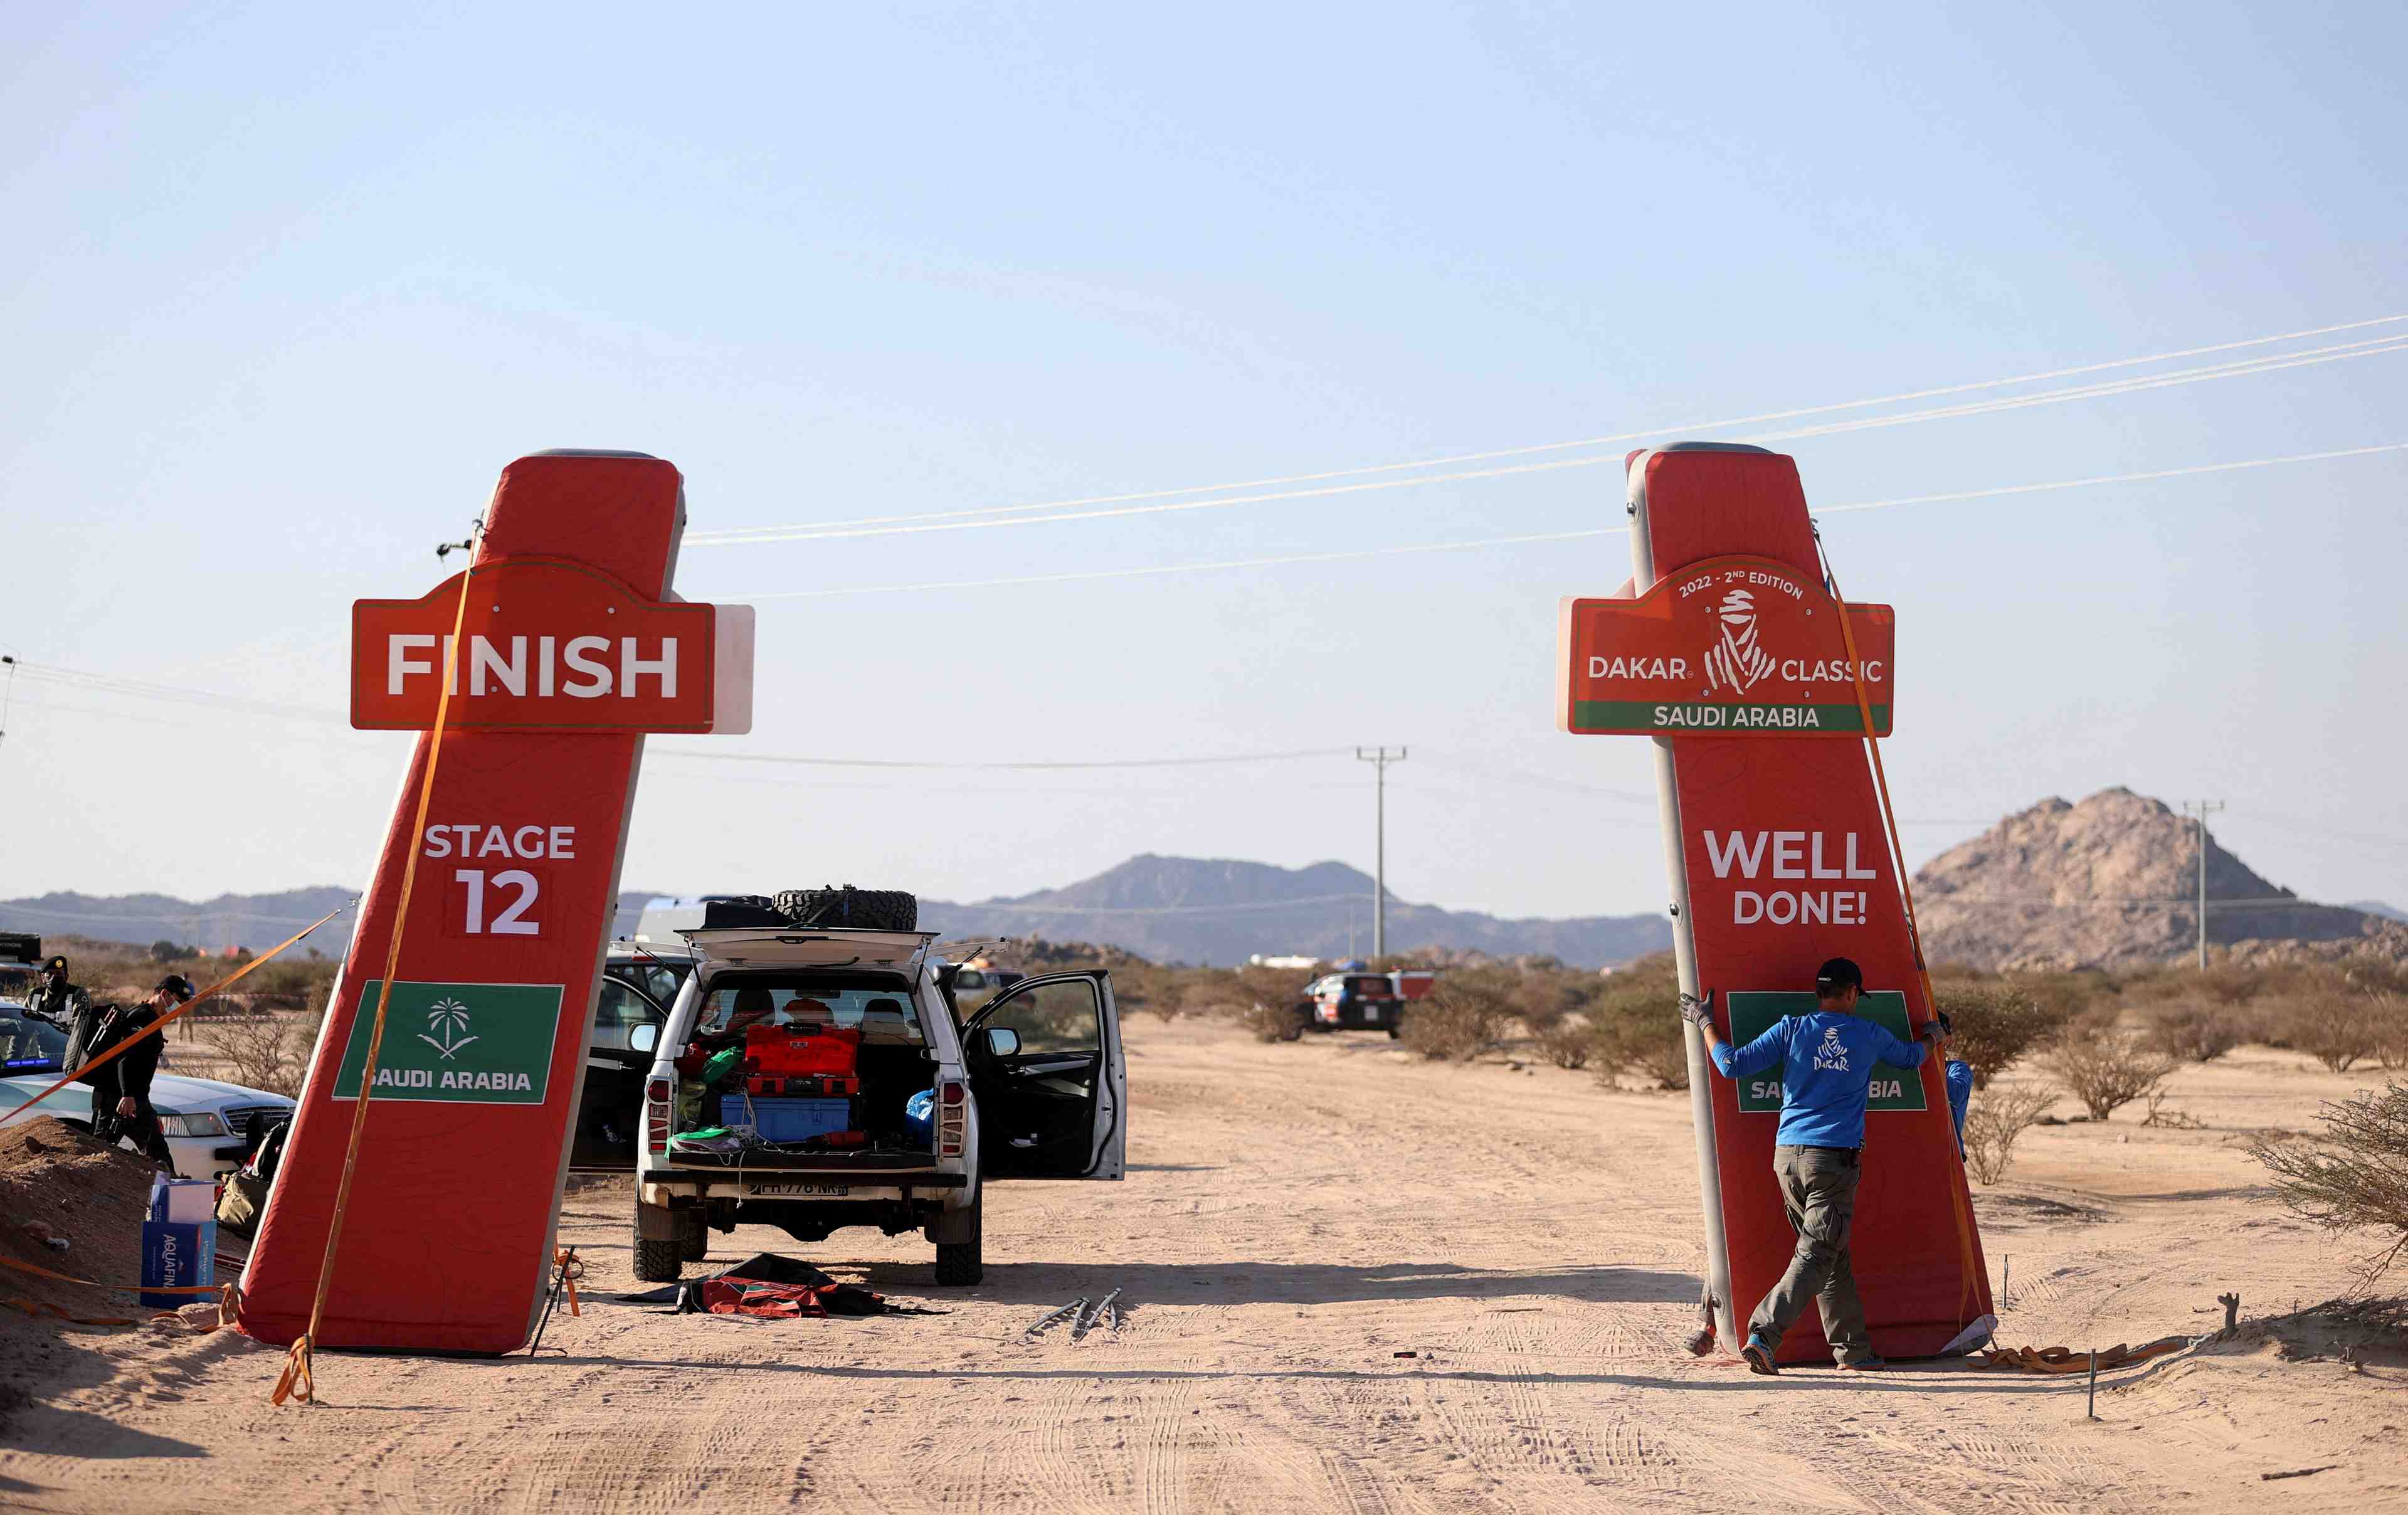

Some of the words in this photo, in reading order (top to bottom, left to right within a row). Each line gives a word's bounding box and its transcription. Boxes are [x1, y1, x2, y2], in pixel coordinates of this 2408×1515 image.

[1678, 575, 1713, 598] 2022
[1724, 570, 1746, 584] 2ND
[1748, 571, 1803, 601] EDITION
[388, 634, 679, 699] FINISH
[1588, 657, 1687, 680] DAKAR
[1781, 660, 1882, 682] CLASSIC
[1653, 705, 1726, 727] SAUDI
[1731, 707, 1820, 728] ARABIA
[425, 824, 576, 859] STAGE
[1703, 830, 1877, 880] WELL
[455, 868, 540, 935] 12
[1733, 890, 1867, 925] DONE!
[1813, 1056, 1850, 1072] DAKAR
[440, 1071, 532, 1091] ARABIA
[161, 1233, 176, 1289] AQUAFIN
